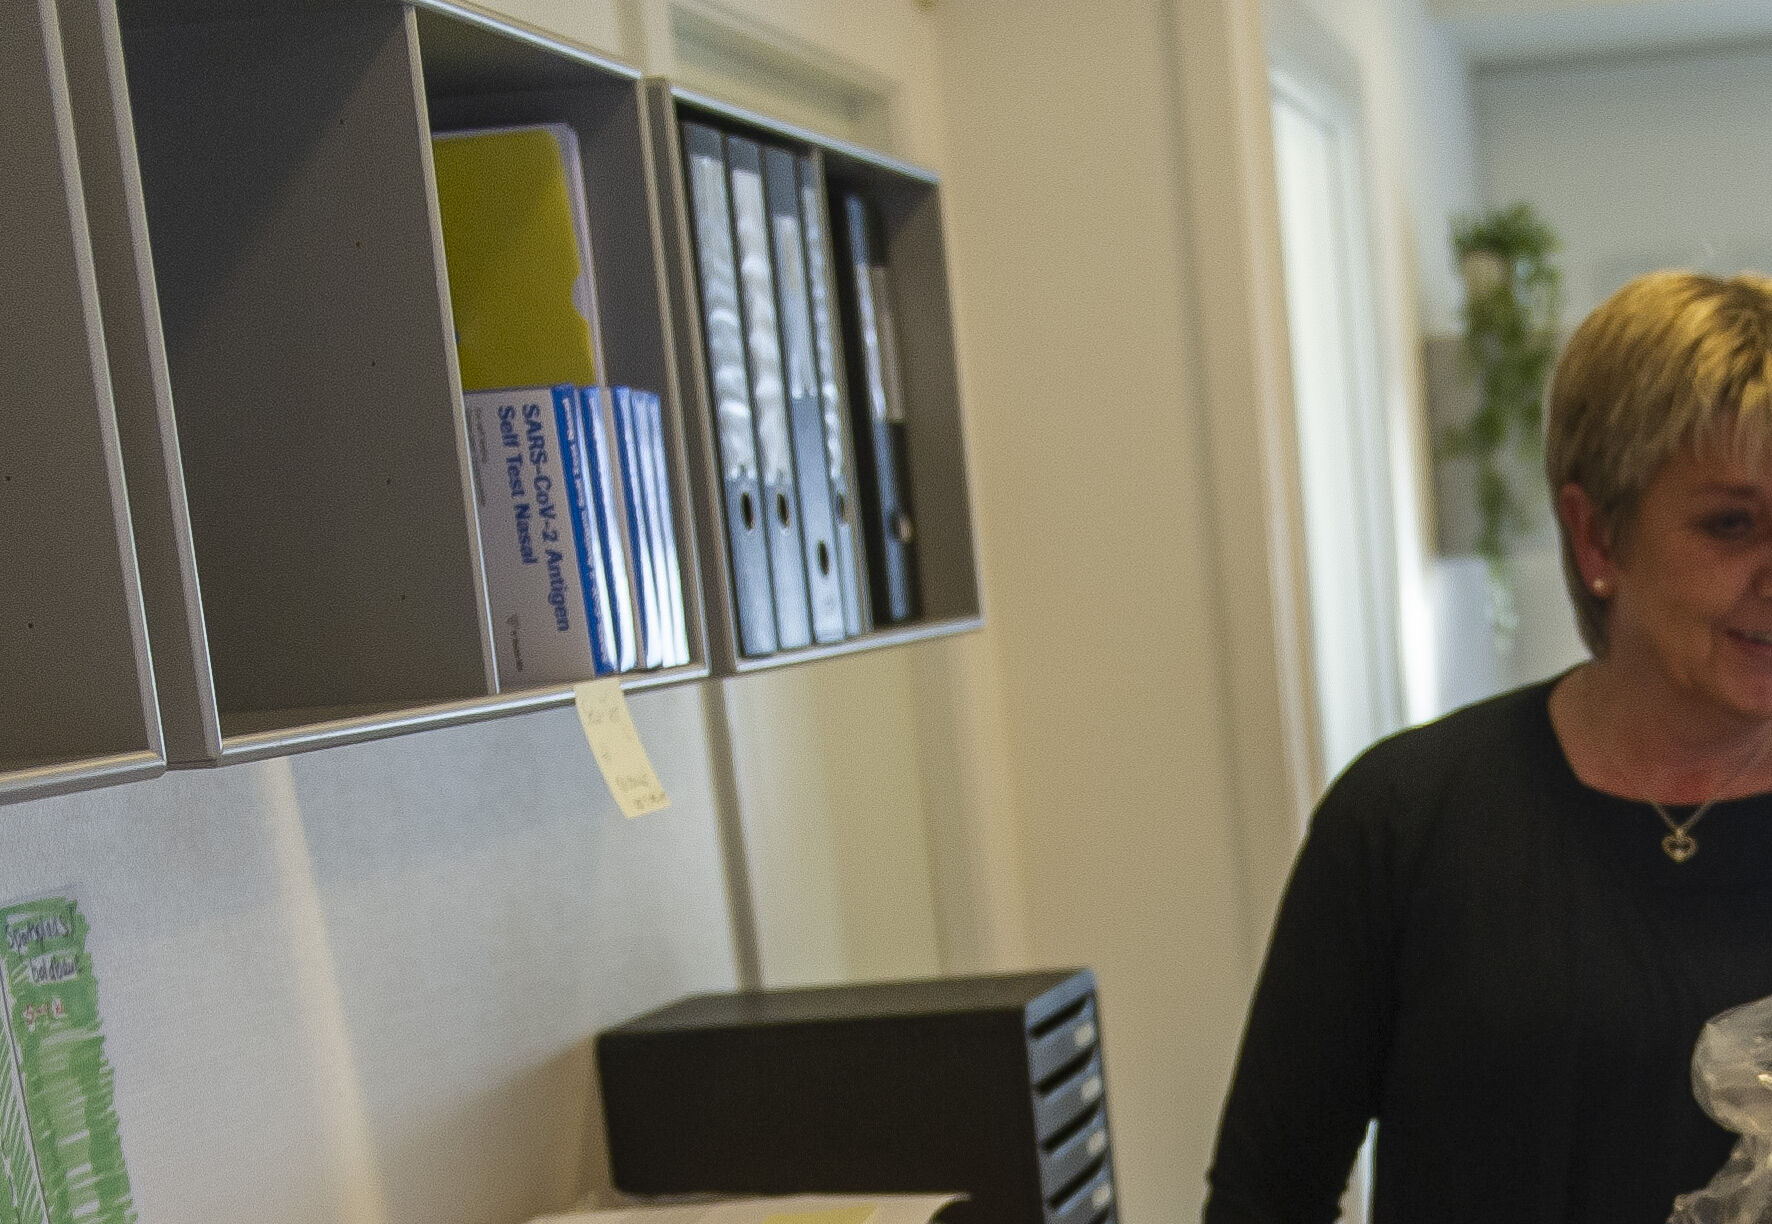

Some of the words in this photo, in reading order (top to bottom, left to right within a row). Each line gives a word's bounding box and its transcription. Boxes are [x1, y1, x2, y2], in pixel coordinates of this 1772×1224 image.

[498, 404, 521, 448] Self
[506, 453, 525, 499] Test
[514, 502, 539, 565] Nasal
[522, 404, 558, 542] SARS-CoV-2
[546, 549, 570, 631] Antigen
